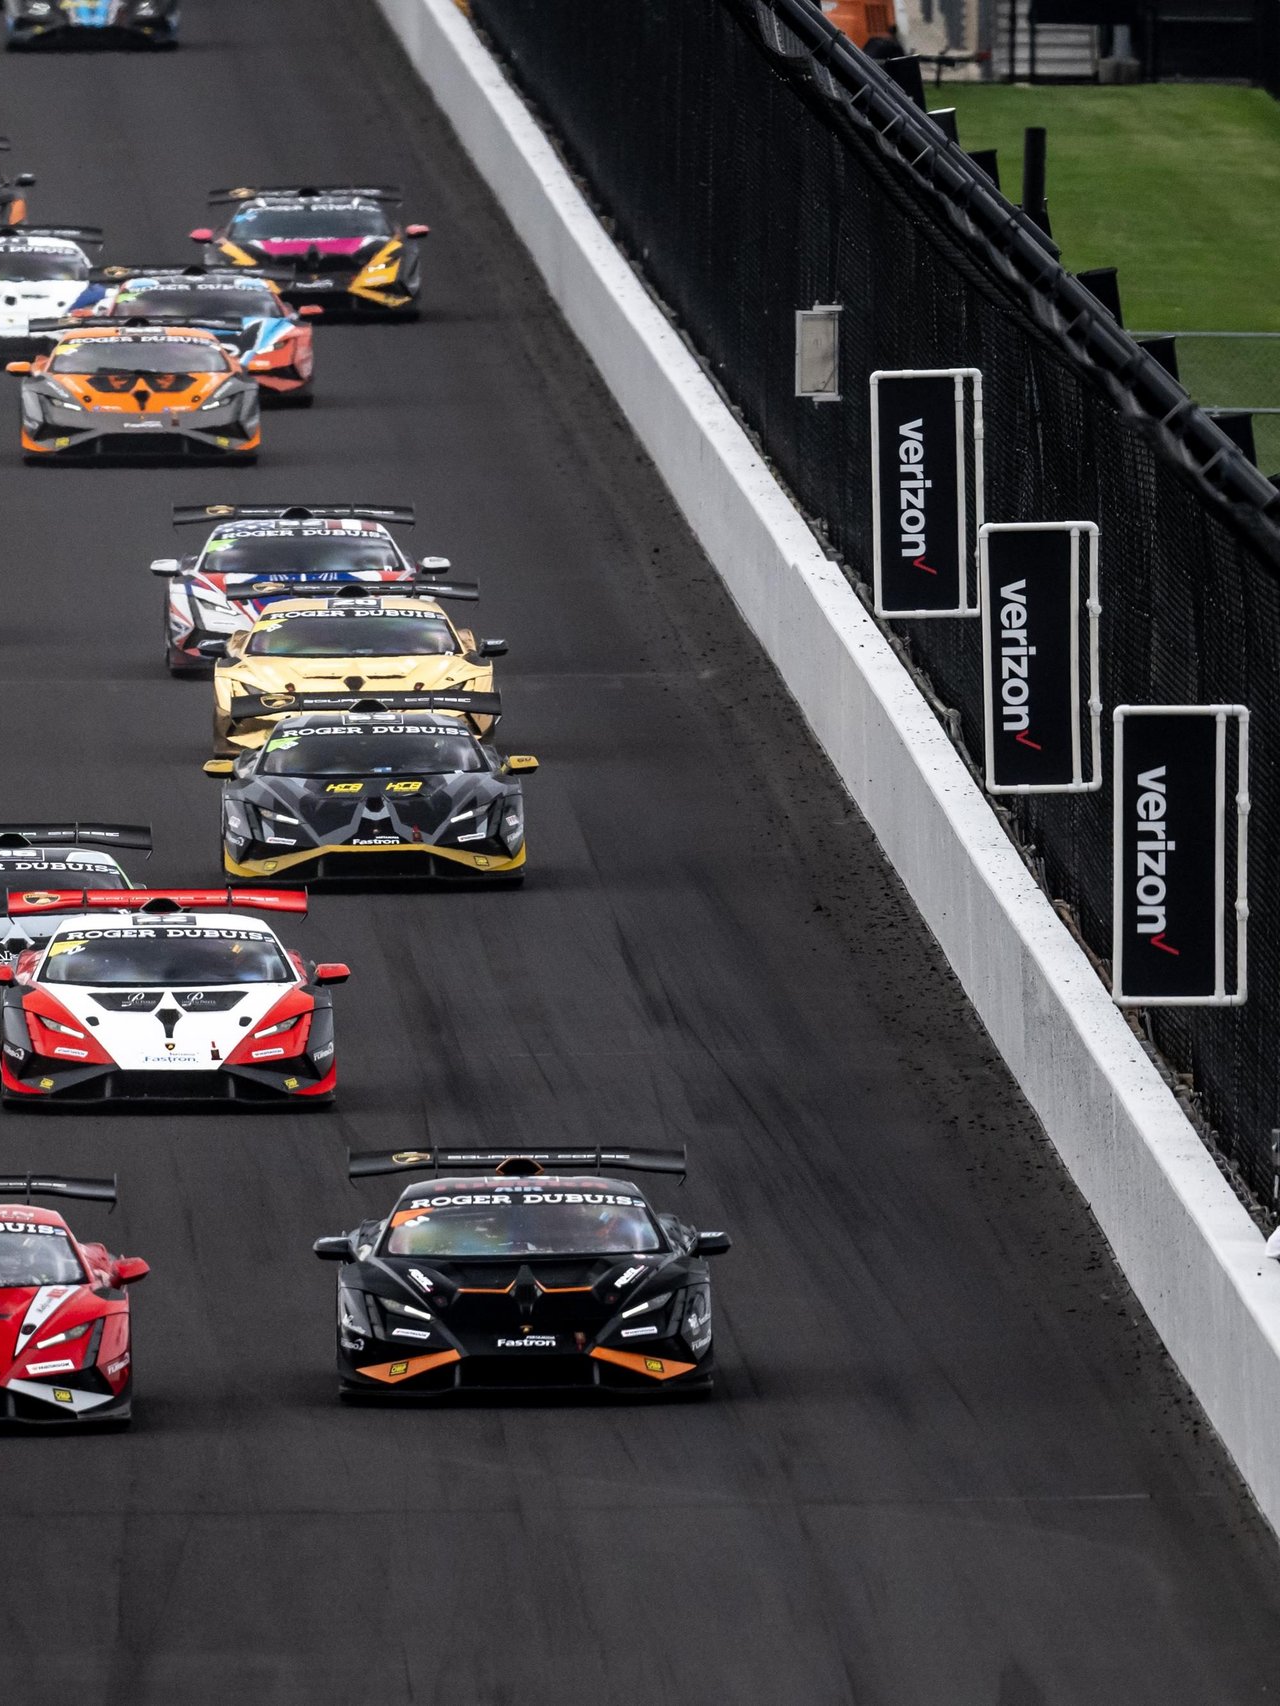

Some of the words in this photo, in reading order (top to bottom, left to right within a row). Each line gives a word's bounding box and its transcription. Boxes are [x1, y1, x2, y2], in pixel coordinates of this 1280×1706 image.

[70, 336, 133, 345] ROGER
[140, 335, 212, 346] DUBUIS
[898, 417, 932, 559] verizon
[222, 529, 294, 539] ROGER
[302, 529, 381, 539] DUBUIS
[270, 609, 346, 620] ROGER
[354, 609, 438, 620] DUBUIS
[999, 577, 1037, 732] verizon
[282, 726, 363, 737] ROGER
[372, 726, 459, 737] DUBUIS
[1136, 764, 1176, 935] verizon
[15, 861, 110, 873] DUBUIS
[66, 929, 157, 941] ROGER
[166, 929, 268, 941] DUBUIS
[410, 1195, 512, 1210] ROGER
[522, 1193, 633, 1207] DUBUIS
[496, 1338, 557, 1348] Fastron
